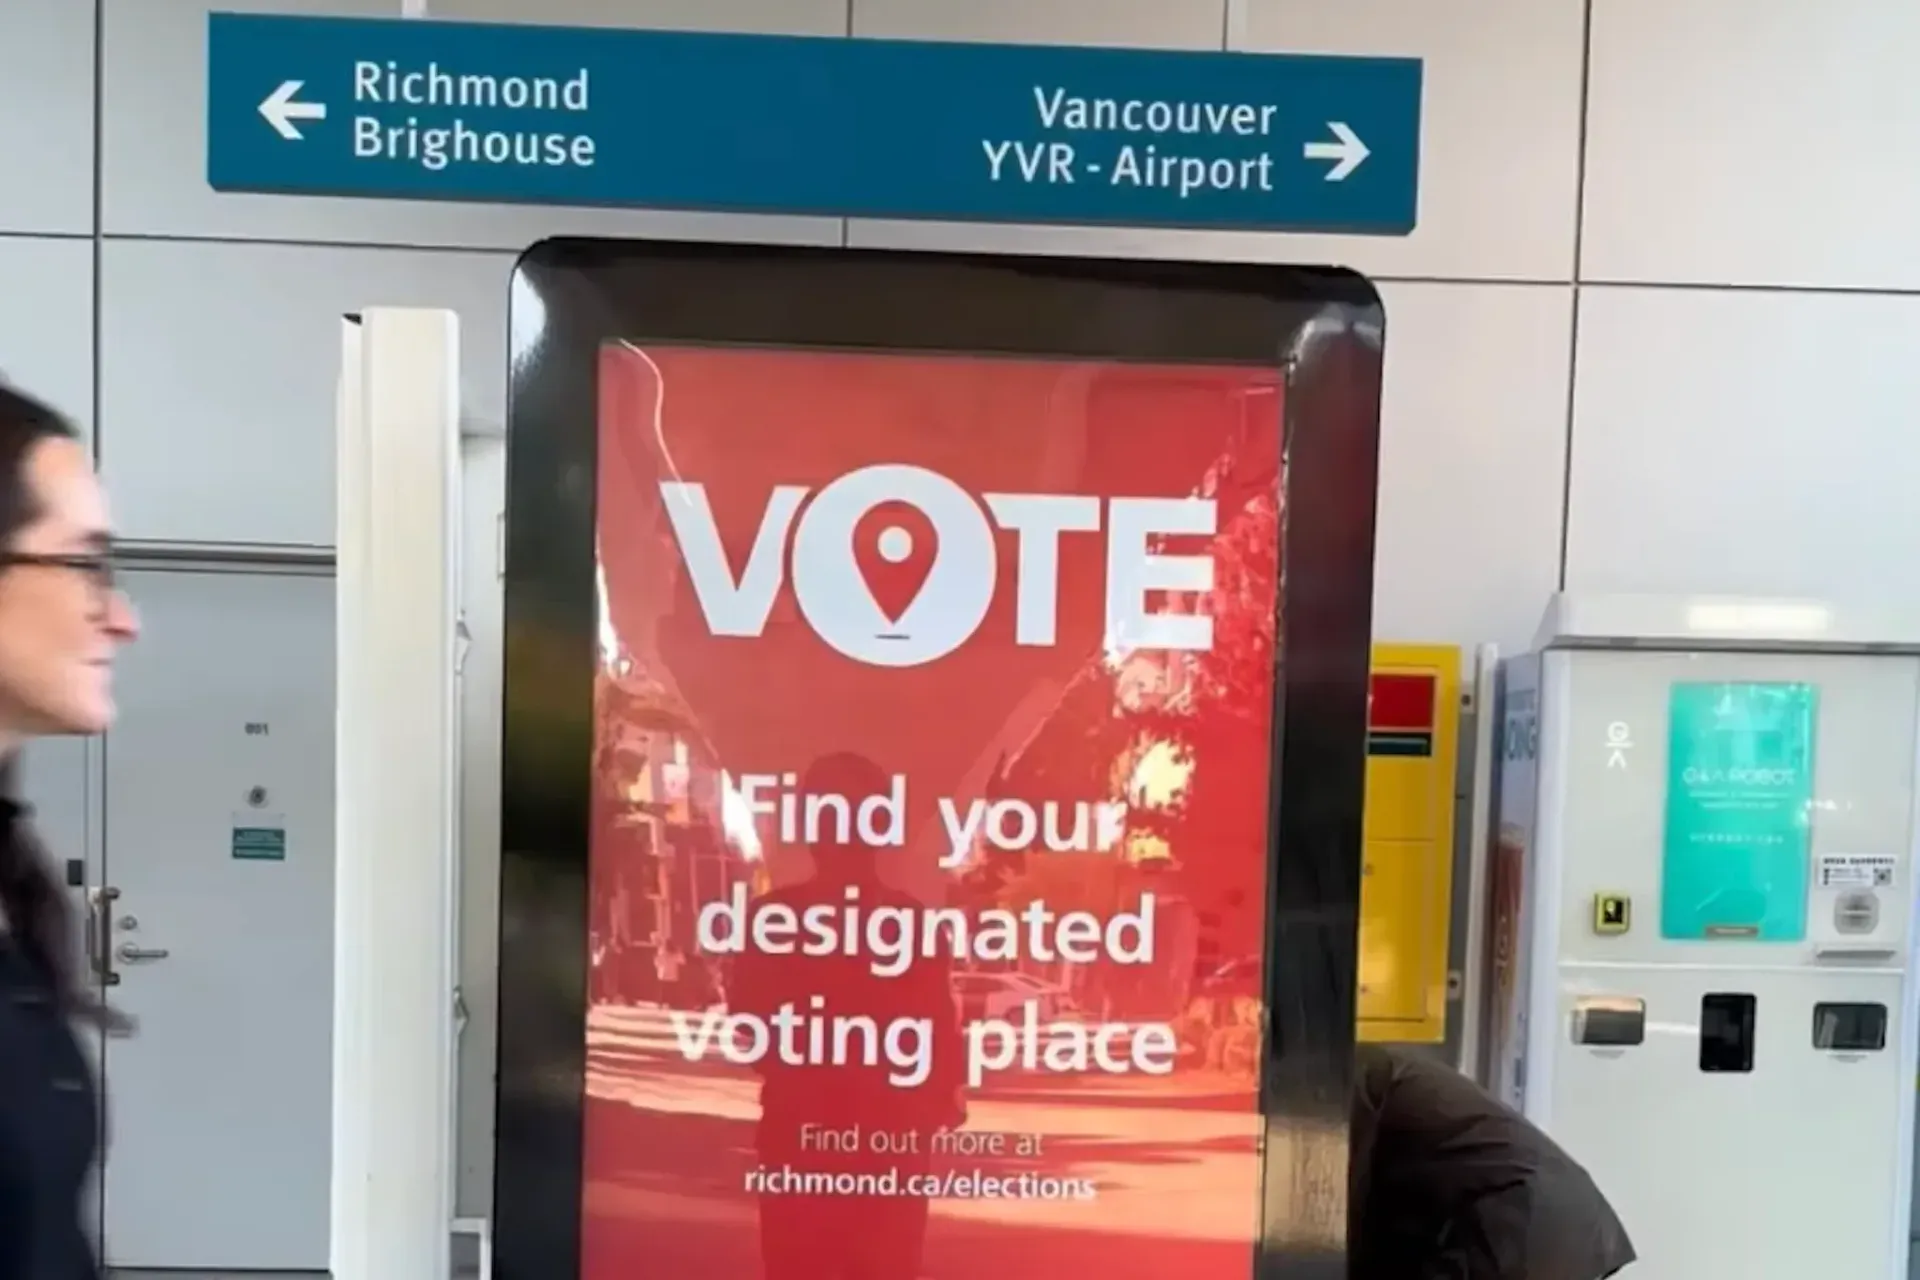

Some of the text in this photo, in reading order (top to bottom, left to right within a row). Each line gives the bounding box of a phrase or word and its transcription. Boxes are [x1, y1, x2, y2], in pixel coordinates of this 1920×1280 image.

[355, 61, 588, 110] Richmond
[1033, 86, 1277, 135] Vancouver
[354, 116, 595, 170] Brighouse
[982, 140, 1075, 183] YVR
[1110, 145, 1273, 198] Airport
[658, 463, 1217, 667] VOTE
[737, 773, 1127, 868] Find your
[698, 882, 1155, 977] designated
[671, 995, 1177, 1088] voting place
[801, 1123, 1044, 1156] Find out more at
[745, 1165, 1096, 1199] richmond.ca/elections
